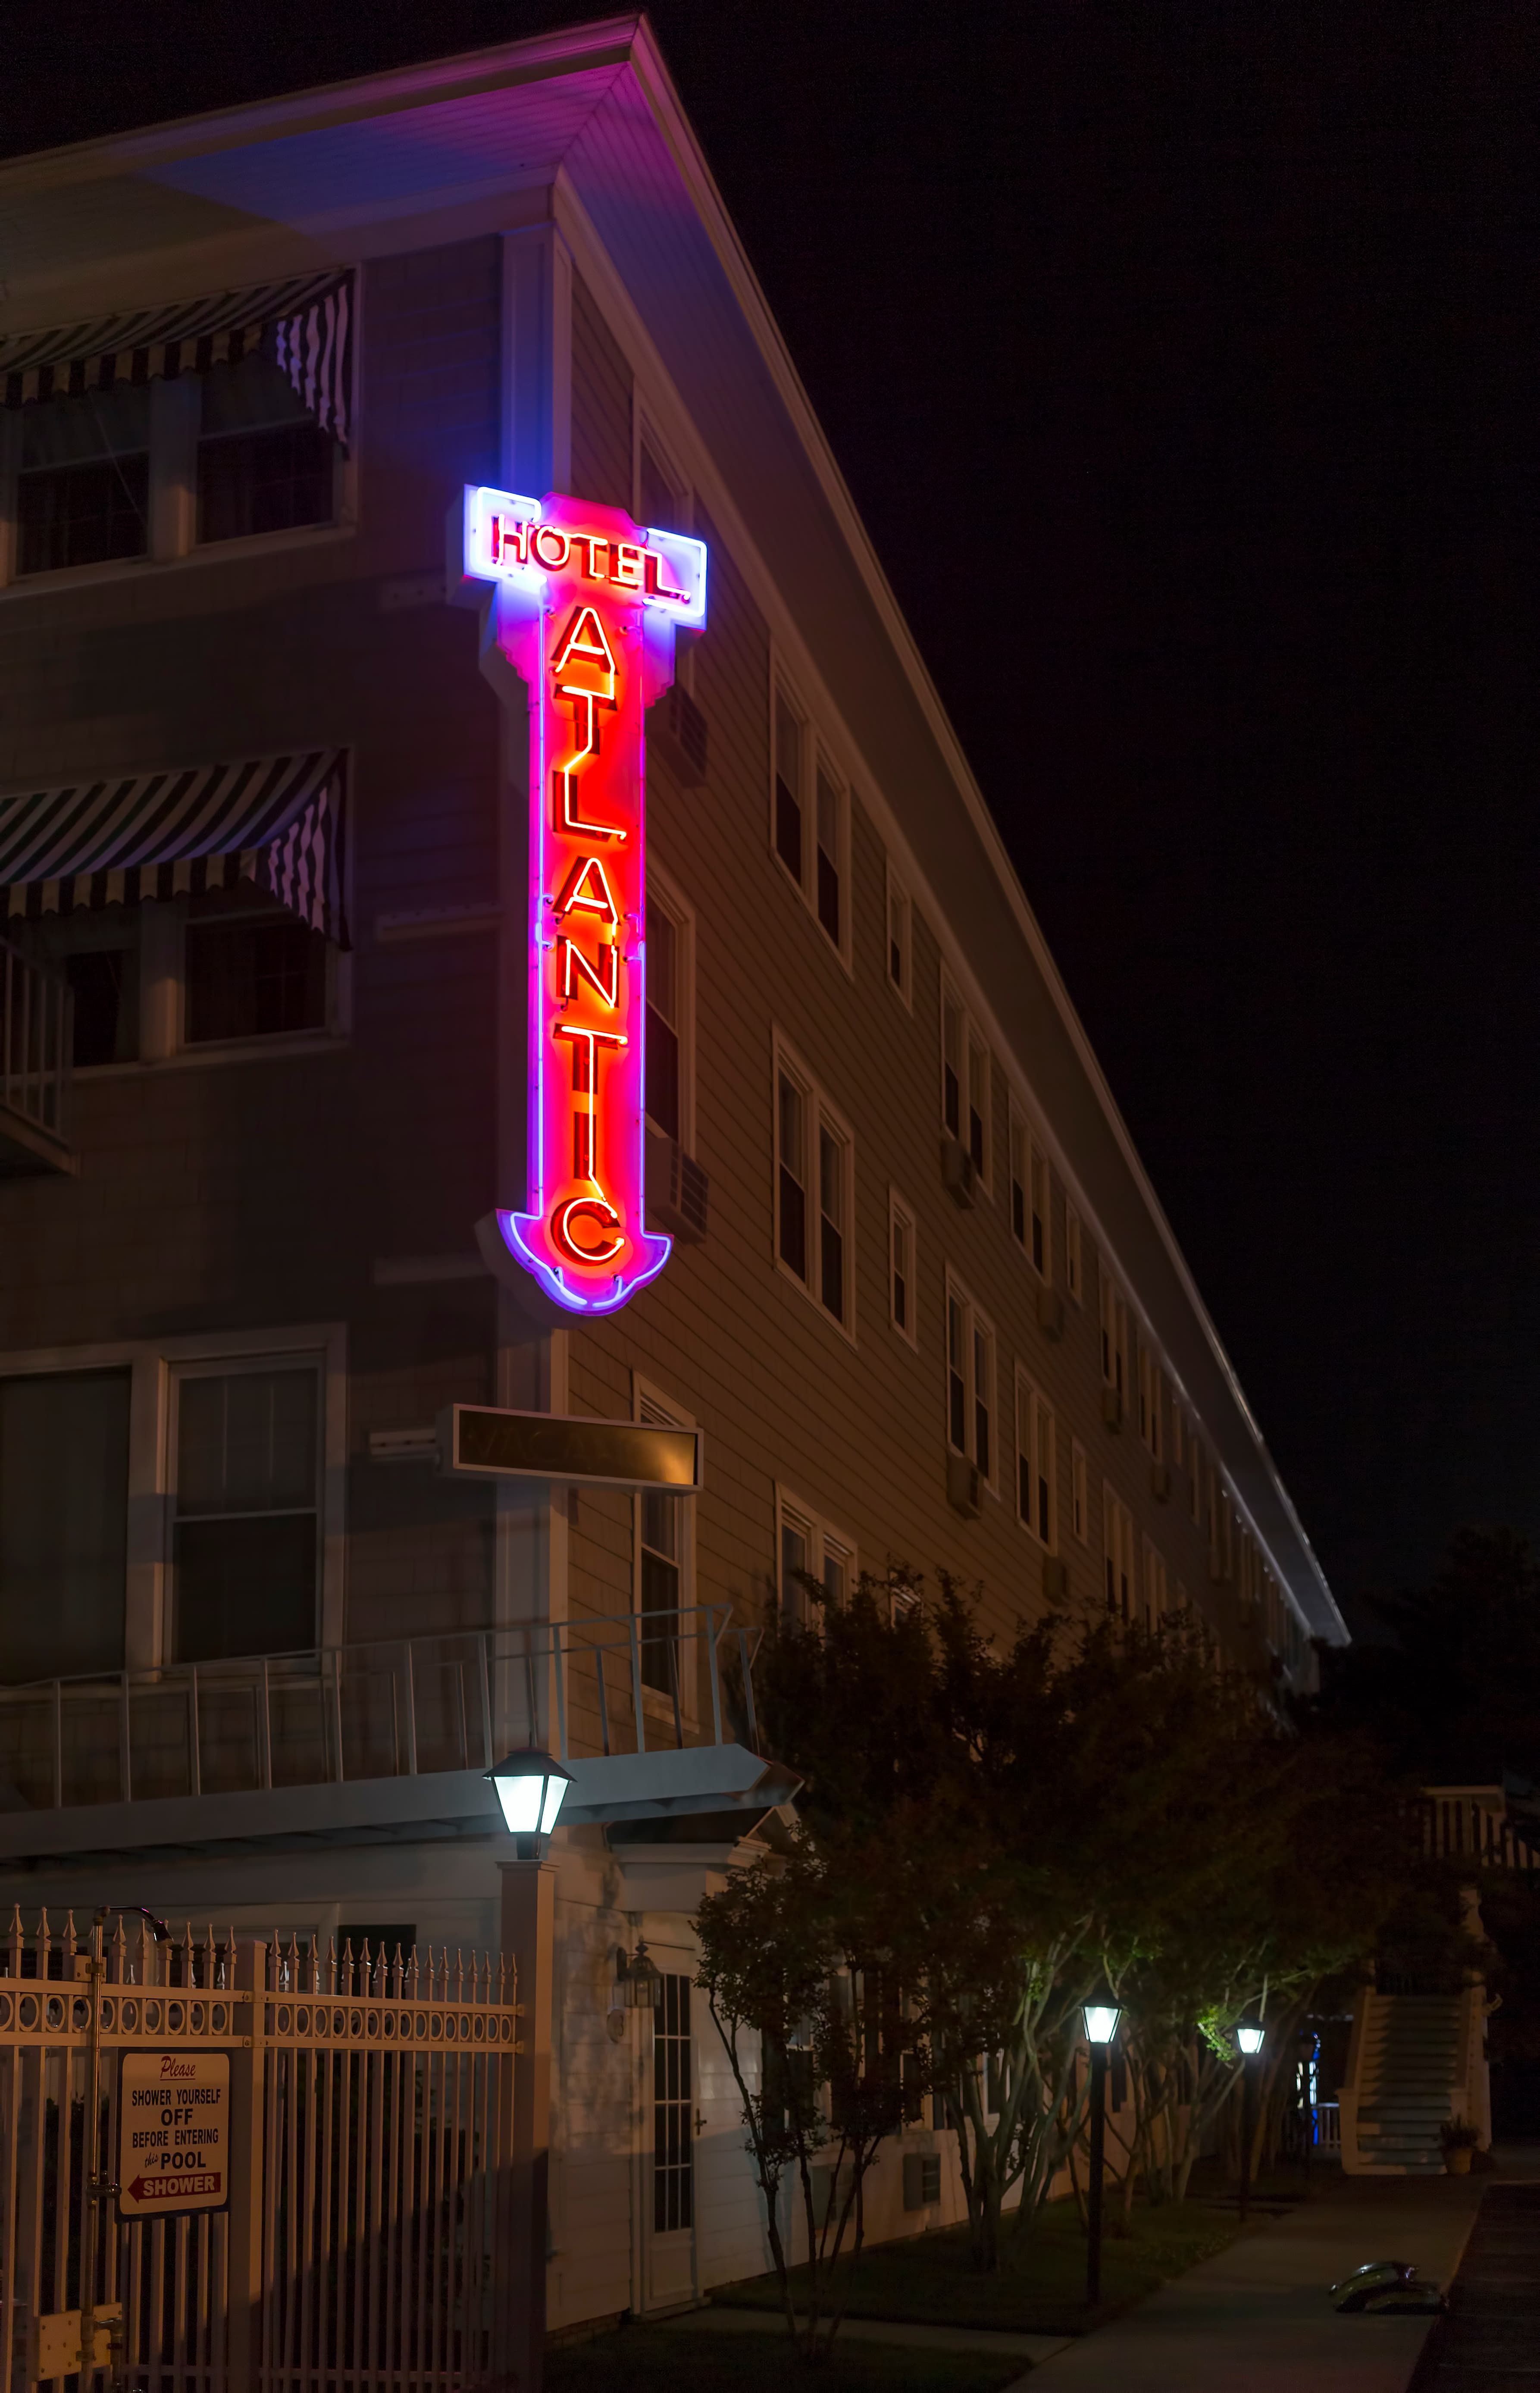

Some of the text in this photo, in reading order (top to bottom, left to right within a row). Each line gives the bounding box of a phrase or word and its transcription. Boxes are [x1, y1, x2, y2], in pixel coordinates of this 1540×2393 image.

[491, 514, 691, 604] HOTEL
[550, 605, 628, 1267] ATLANTIC
[160, 2056, 196, 2080] Please
[132, 2089, 220, 2106] SHOWER YOURSELF
[161, 2108, 193, 2126] OFF
[133, 2129, 218, 2148] BEFORE ENTERING
[144, 2152, 206, 2169] this POOL
[143, 2175, 215, 2196] SHOWER
